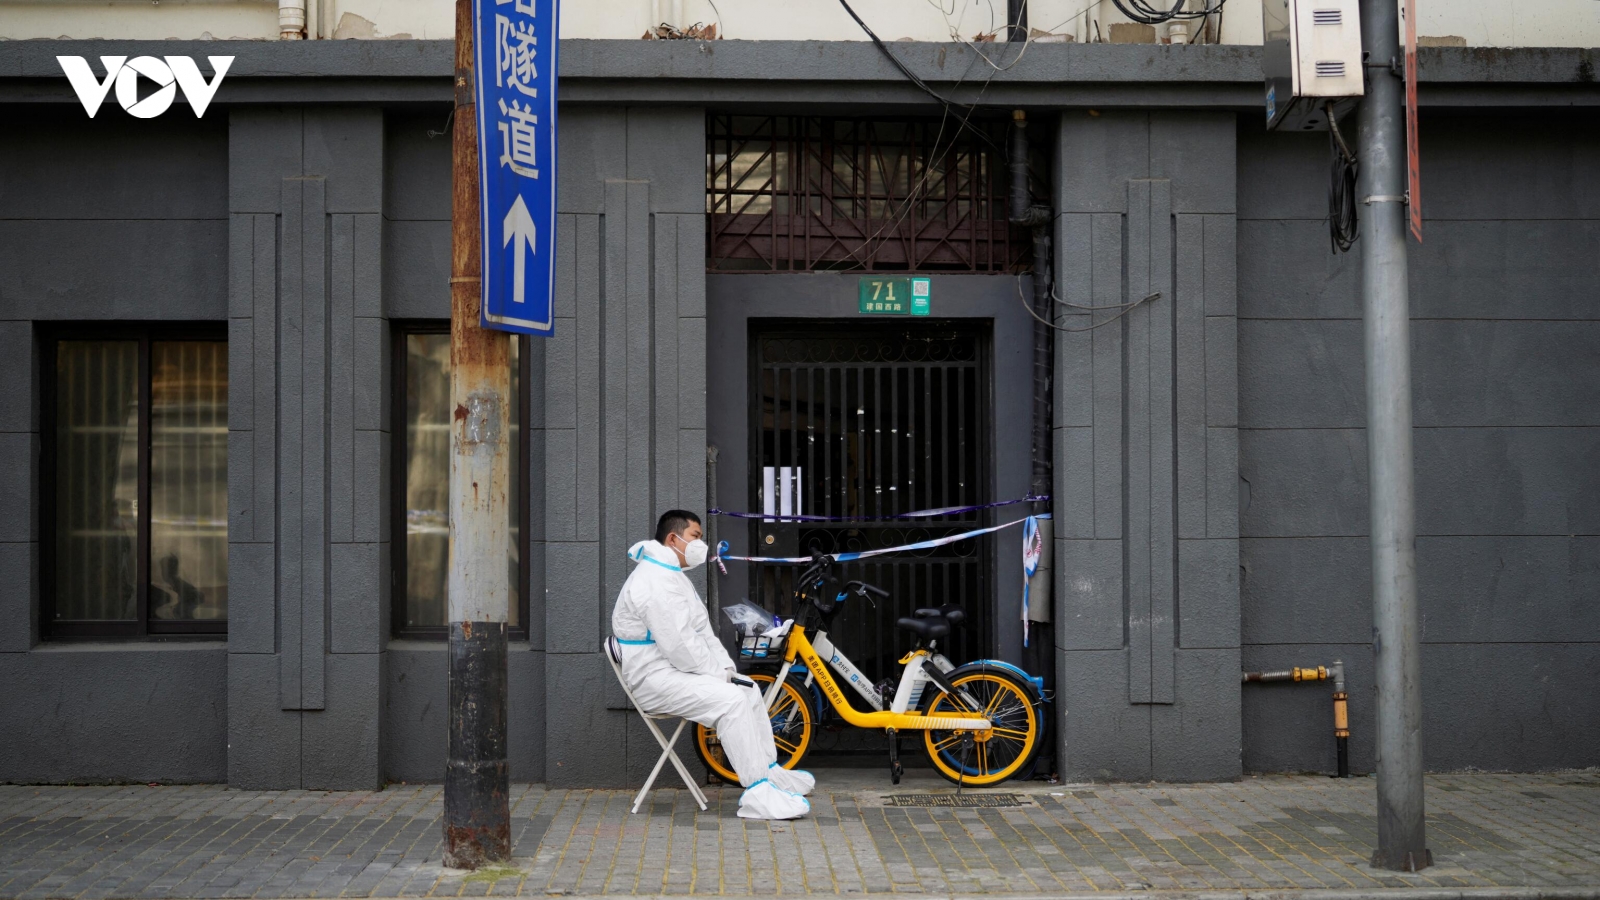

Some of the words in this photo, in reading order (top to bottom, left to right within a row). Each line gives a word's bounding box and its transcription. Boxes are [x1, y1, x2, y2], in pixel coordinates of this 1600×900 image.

[872, 281, 896, 301] 71
[866, 302, 901, 311] 建国西路
